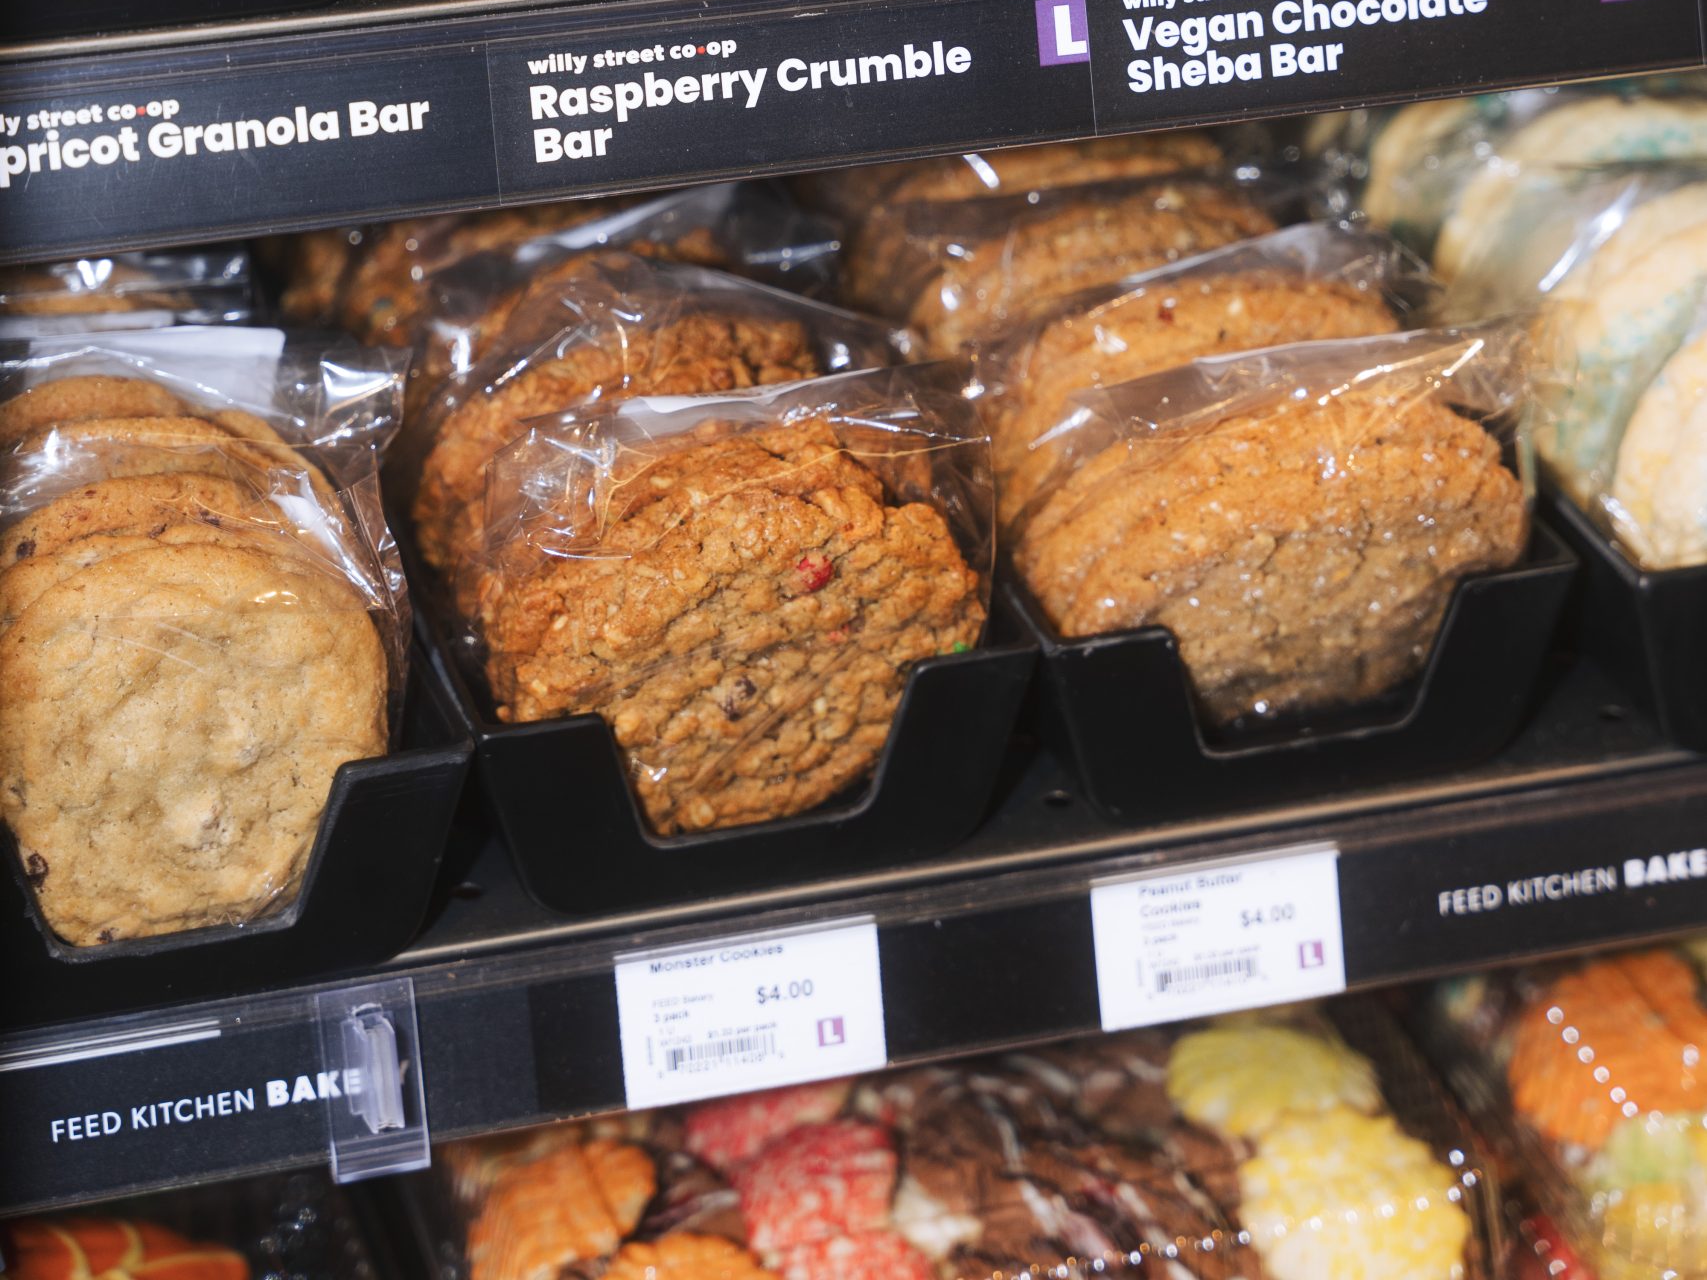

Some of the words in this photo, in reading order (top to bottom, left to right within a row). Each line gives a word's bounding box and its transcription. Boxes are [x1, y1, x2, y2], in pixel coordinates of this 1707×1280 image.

[1054, 5, 1087, 57] L
[1122, 10, 1264, 56] Vegan
[527, 53, 587, 75] willy
[593, 45, 665, 69] street
[529, 65, 767, 122] Raspberry
[777, 41, 971, 92] Crumble
[1127, 47, 1262, 93] Sheba
[1270, 43, 1343, 77] Bar
[27, 104, 103, 131] street
[147, 106, 340, 156] Granola
[348, 100, 430, 137] Bar
[533, 124, 612, 163] Bar
[1439, 885, 1502, 916] FEED
[1507, 866, 1617, 906] KITCHEN
[1240, 904, 1295, 927] $4.00
[650, 954, 714, 973] Monster
[719, 943, 784, 962] Cookies
[756, 979, 814, 1004] $4.00
[51, 1111, 122, 1143] FEED
[131, 1088, 255, 1130] KITCHEN
